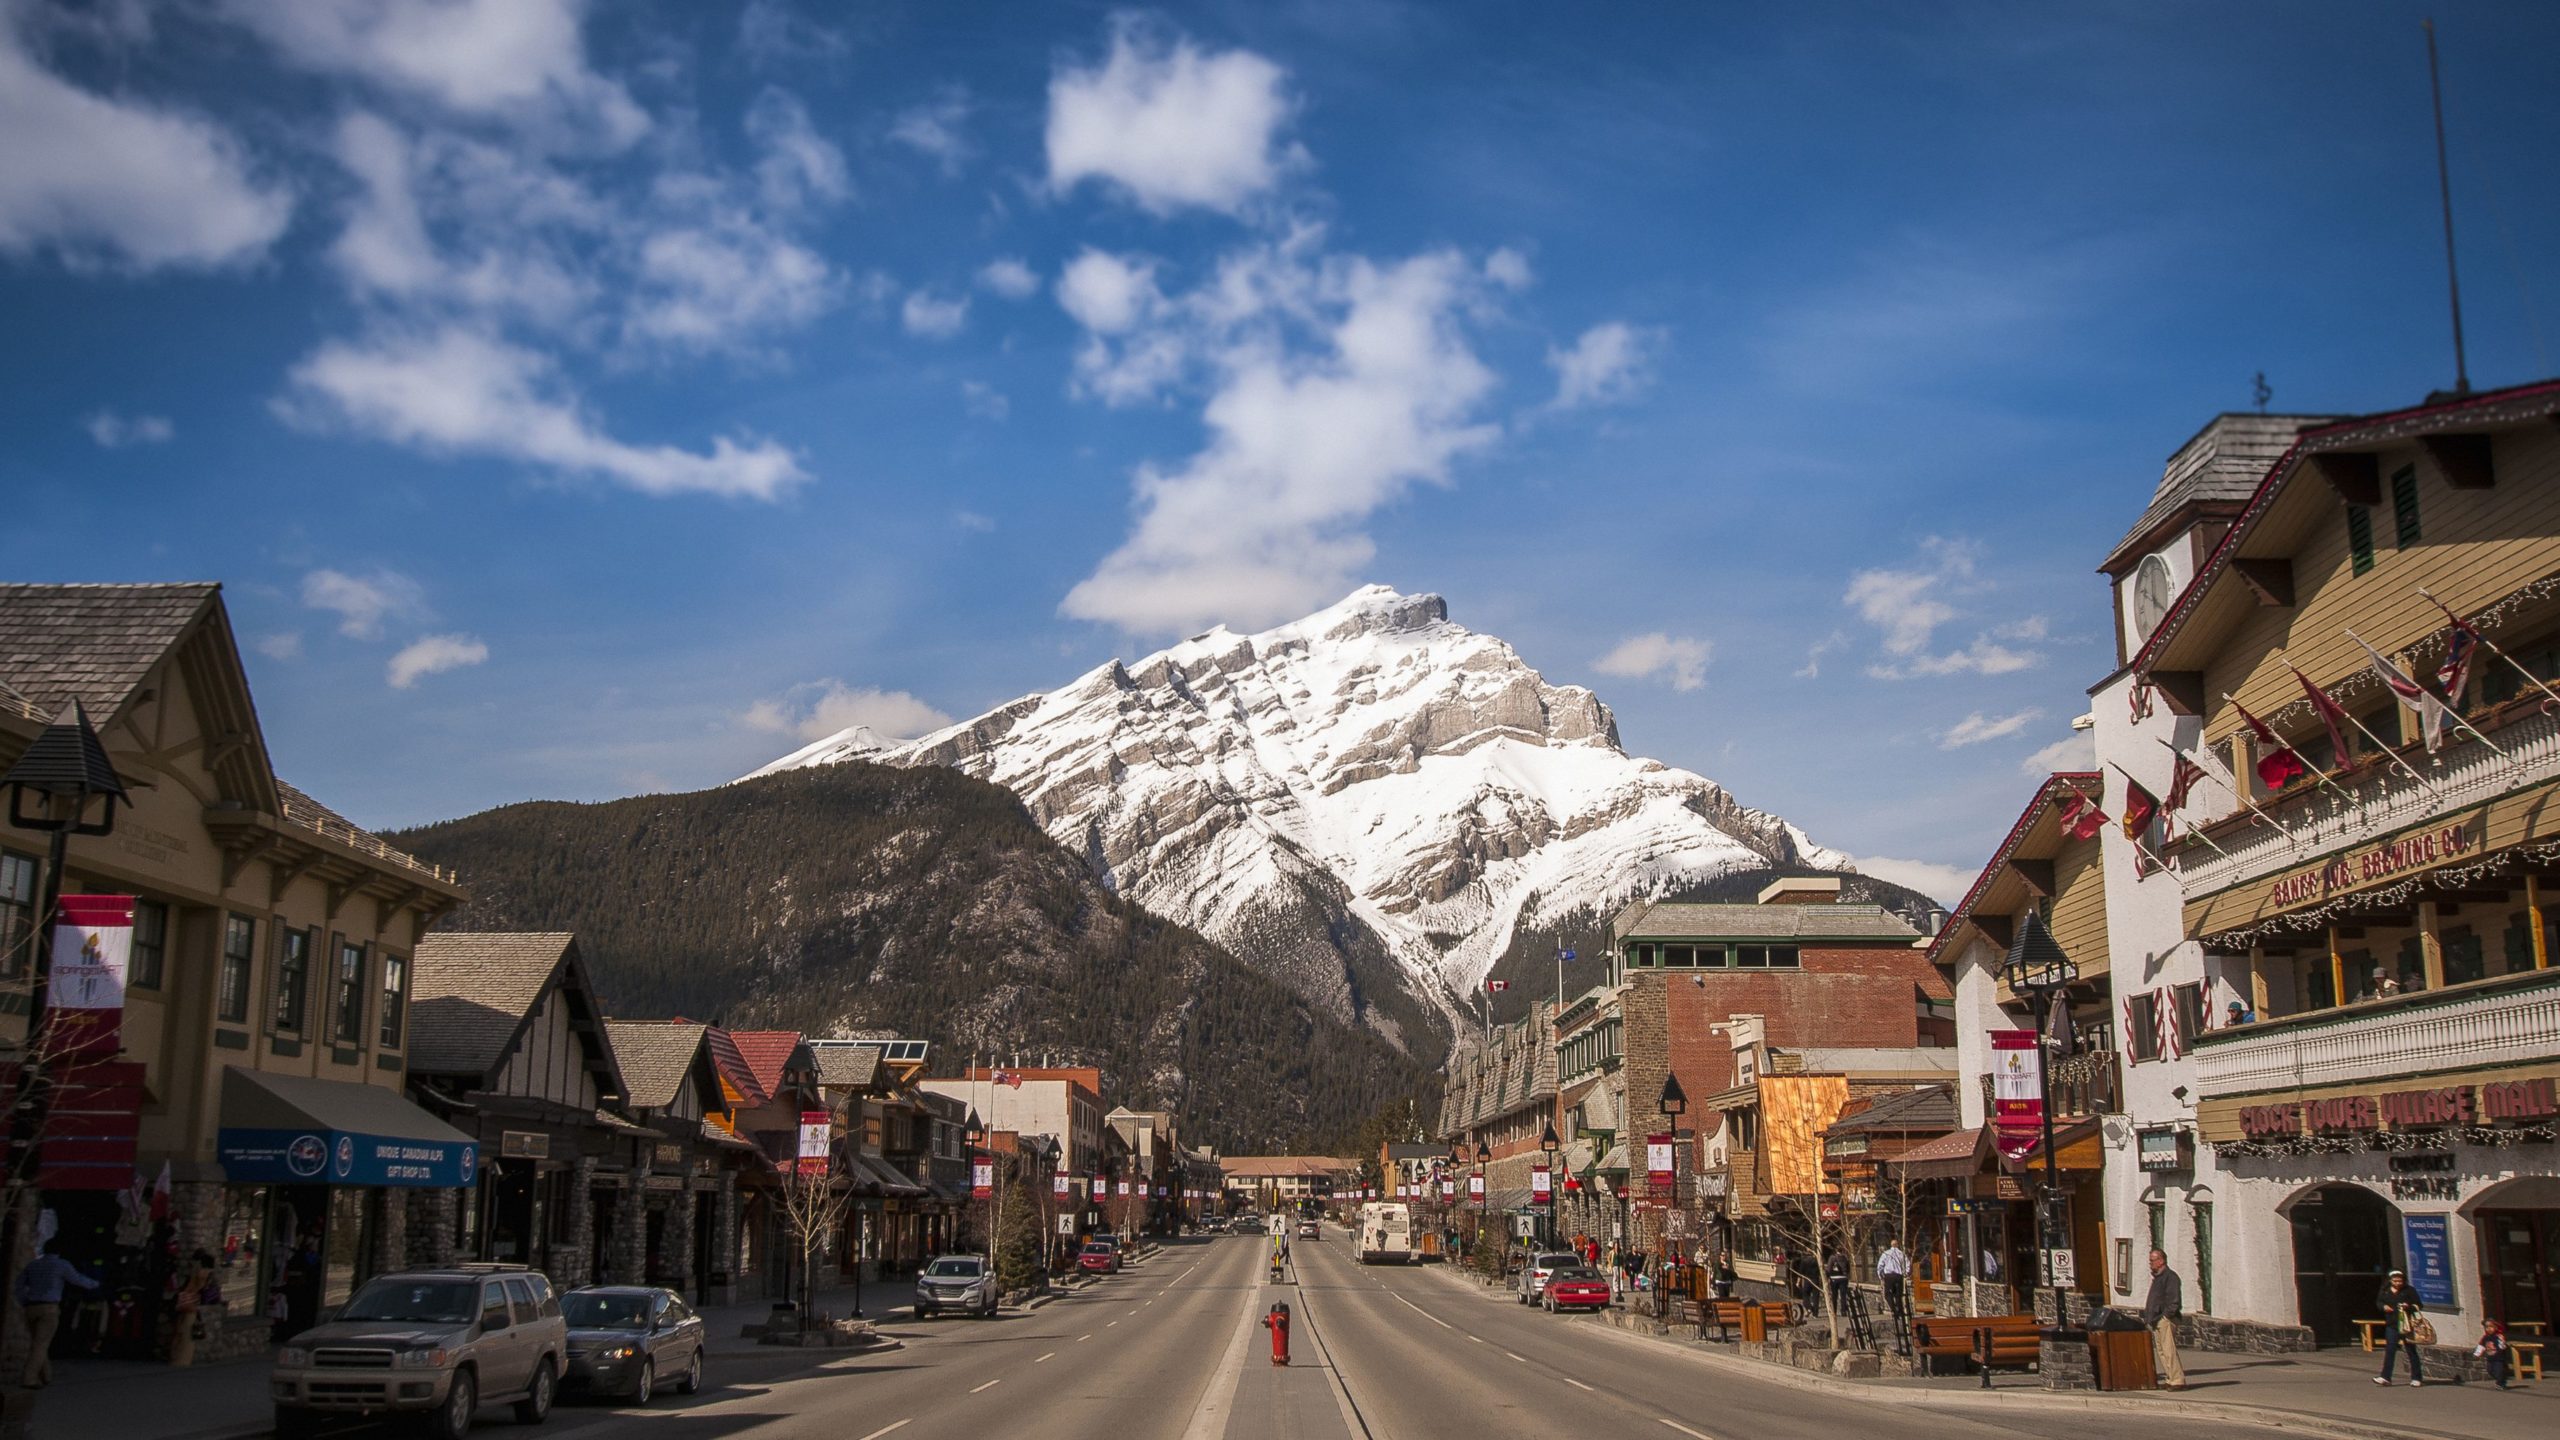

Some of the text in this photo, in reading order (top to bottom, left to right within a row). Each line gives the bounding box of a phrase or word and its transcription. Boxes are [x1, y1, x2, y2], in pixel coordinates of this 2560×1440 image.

[2274, 825, 2470, 905] BANFF AVE. BREWING CO.
[2239, 1078, 2556, 1136] CLOCK TOWER VILLAGE MALL
[376, 1145, 444, 1162] UNIQUE CANADIAN ALPS
[387, 1165, 432, 1179] GIFT SHOP LTD.
